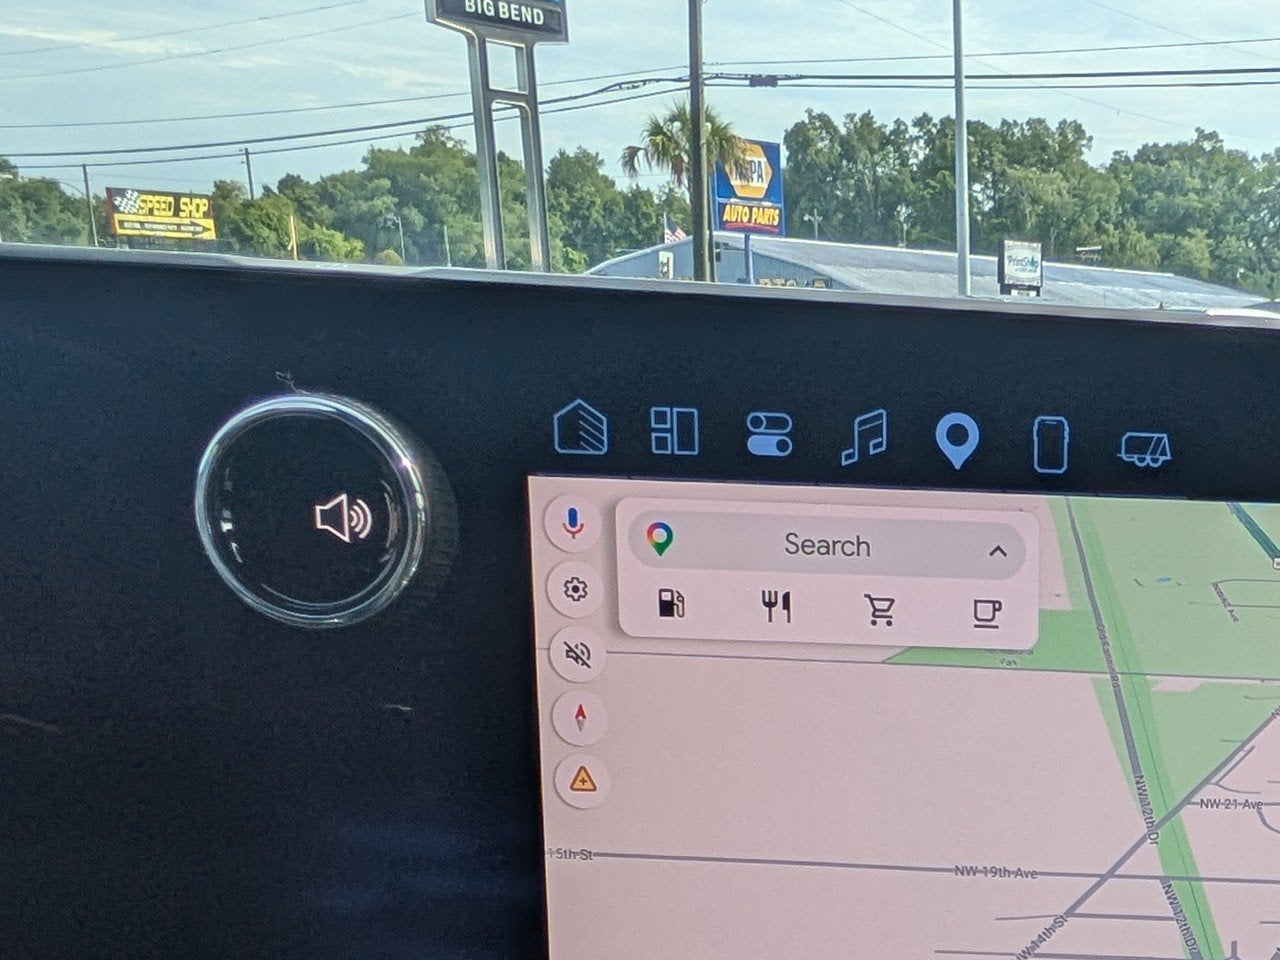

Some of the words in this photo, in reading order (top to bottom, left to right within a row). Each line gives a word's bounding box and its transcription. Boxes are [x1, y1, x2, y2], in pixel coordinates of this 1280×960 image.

[465, 0, 495, 16] BIG
[499, 2, 544, 25] BEND
[138, 194, 174, 217] SPEED
[179, 197, 209, 218] SHOP
[723, 204, 750, 223] AUTO
[751, 206, 780, 226] PARTS
[784, 531, 872, 559] Search
[1134, 774, 1148, 798] NW
[1141, 799, 1157, 829] 12th
[1200, 798, 1221, 810] NW
[1224, 798, 1238, 810] 21
[1242, 798, 1263, 811] Ave
[1148, 831, 1159, 846] Dr
[580, 849, 593, 861] St
[954, 865, 979, 877] NW
[982, 866, 1011, 878] 19th
[1015, 867, 1039, 880] Ave
[1163, 883, 1181, 910] NW
[1174, 909, 1192, 937] 12th
[1185, 938, 1198, 952] Dr
[1031, 926, 1056, 948] 14th
[1053, 914, 1068, 928] St
